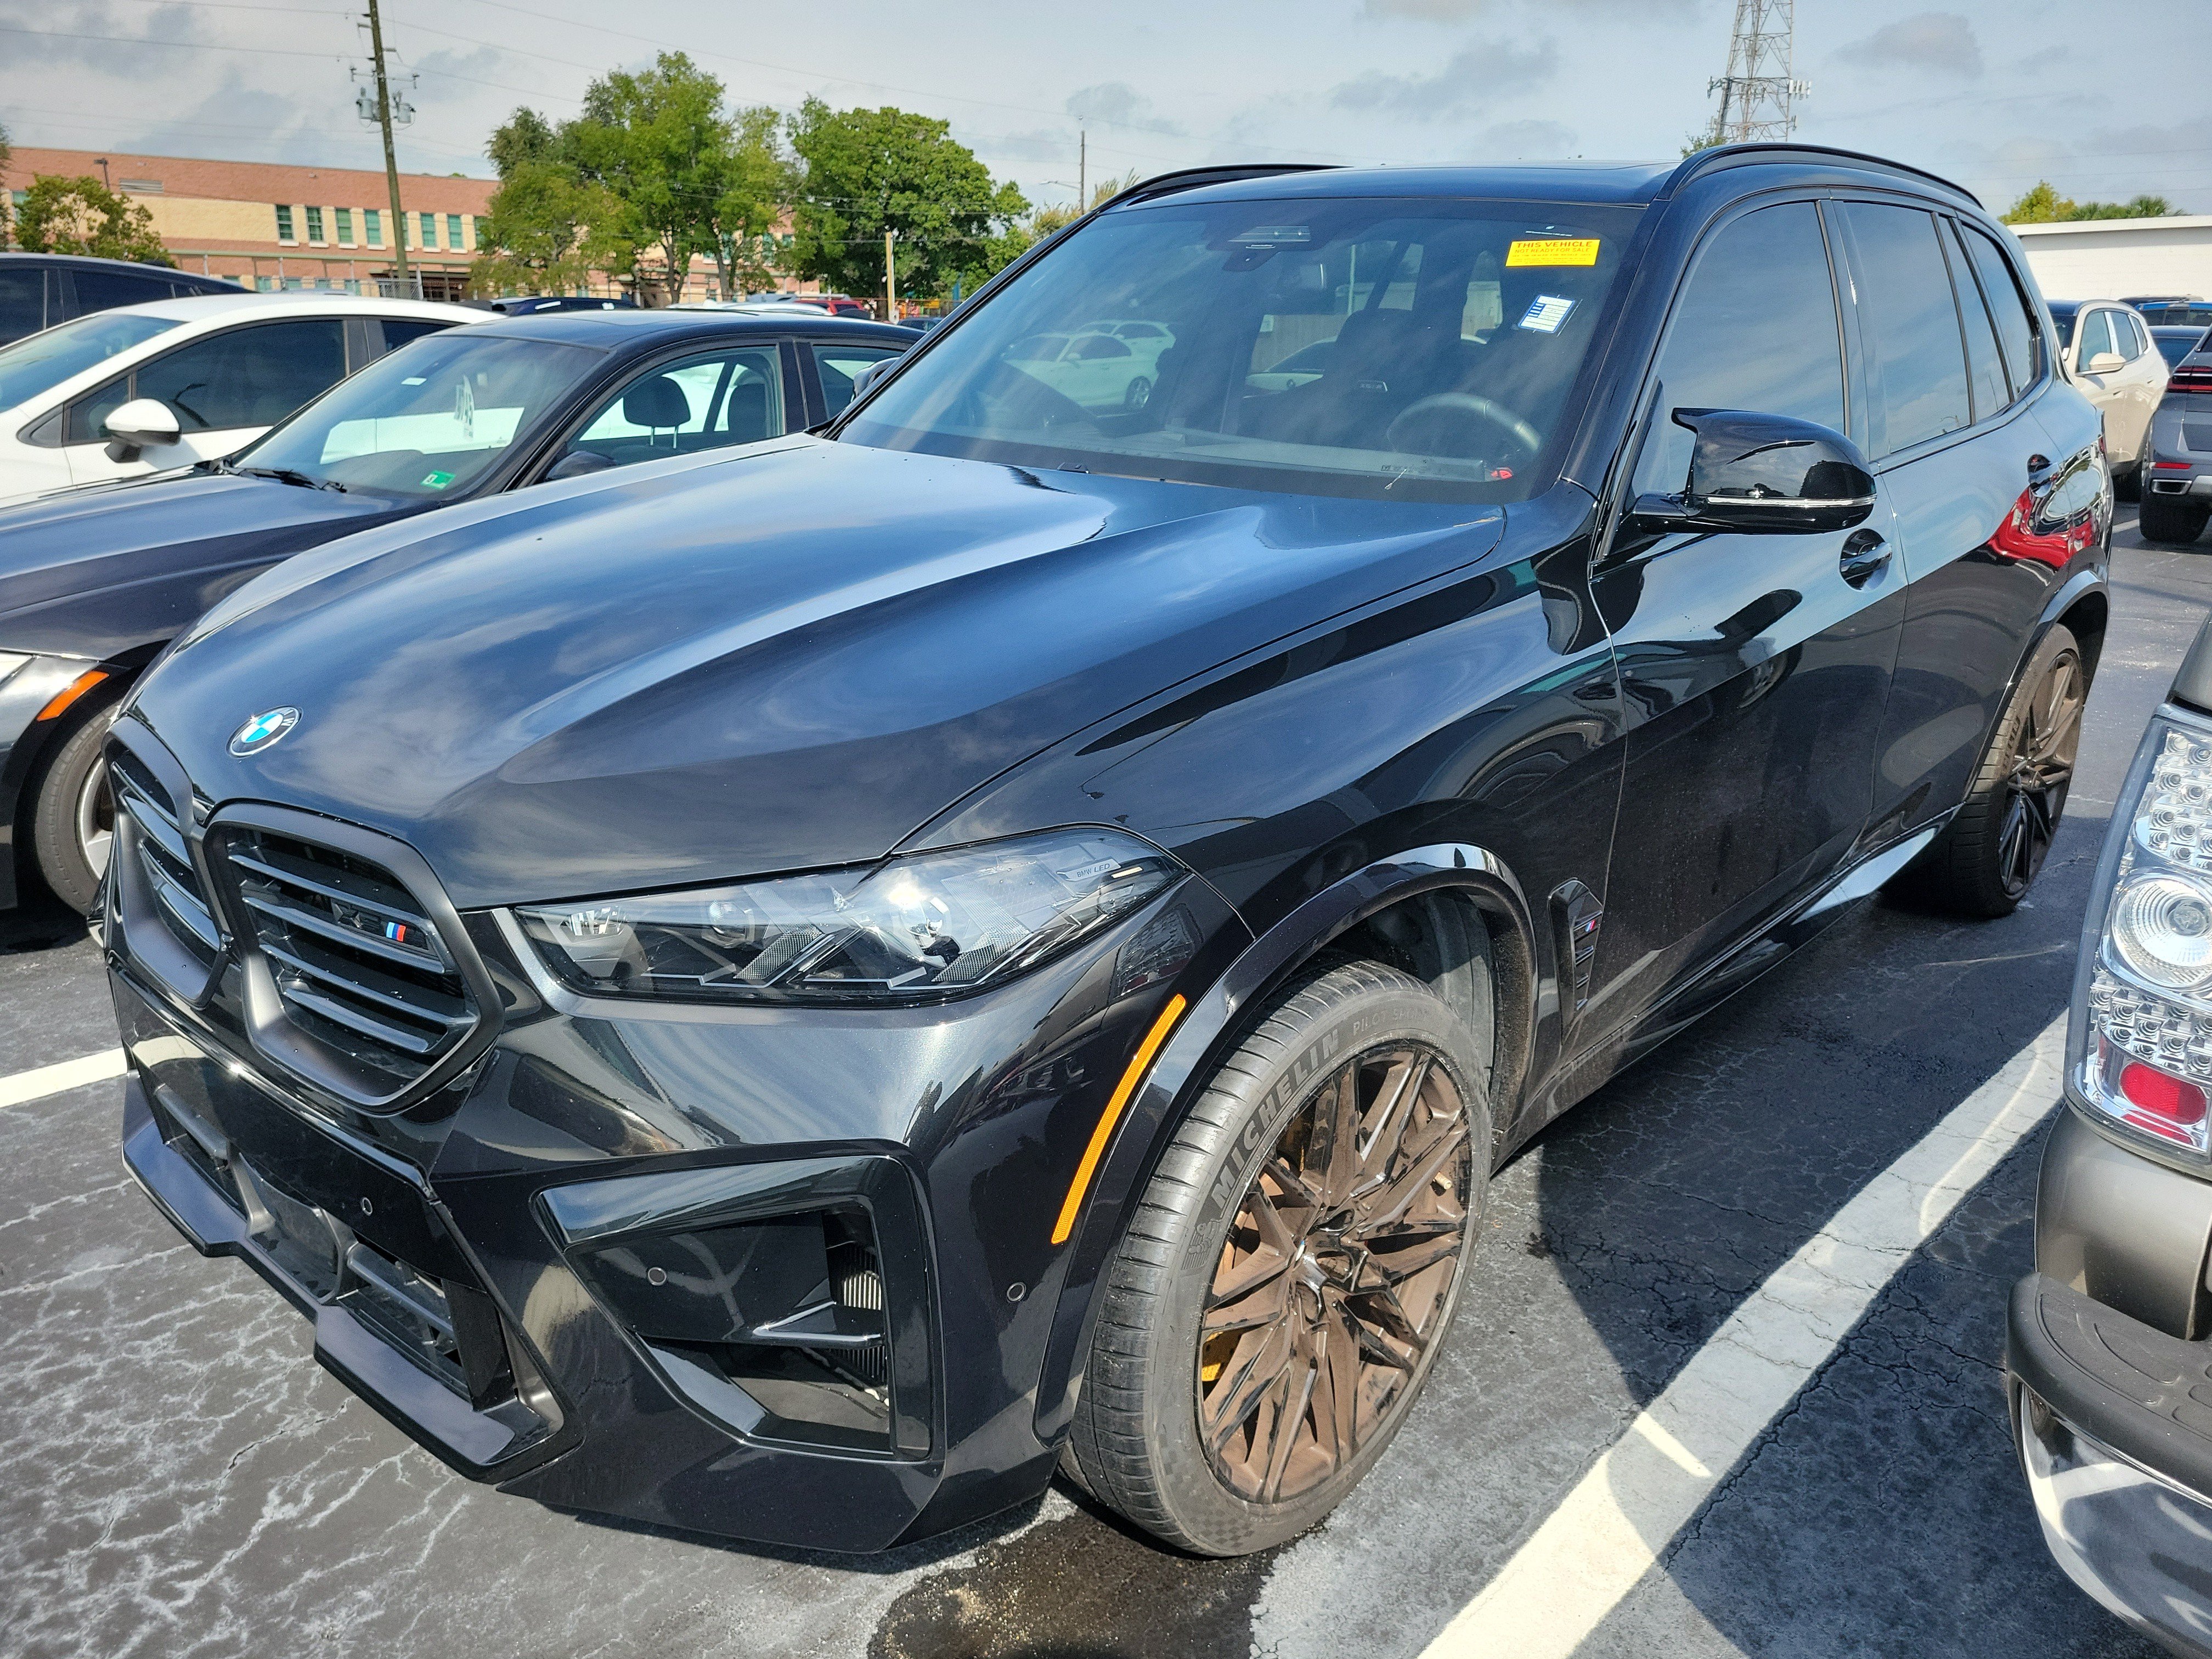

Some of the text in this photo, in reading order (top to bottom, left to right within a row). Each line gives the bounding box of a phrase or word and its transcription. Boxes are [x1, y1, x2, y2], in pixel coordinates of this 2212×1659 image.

[1076, 863, 1110, 878] BMW LED
[1211, 1029, 1339, 1209] MICHELIN
[1353, 1010, 1387, 1036] PILOT
